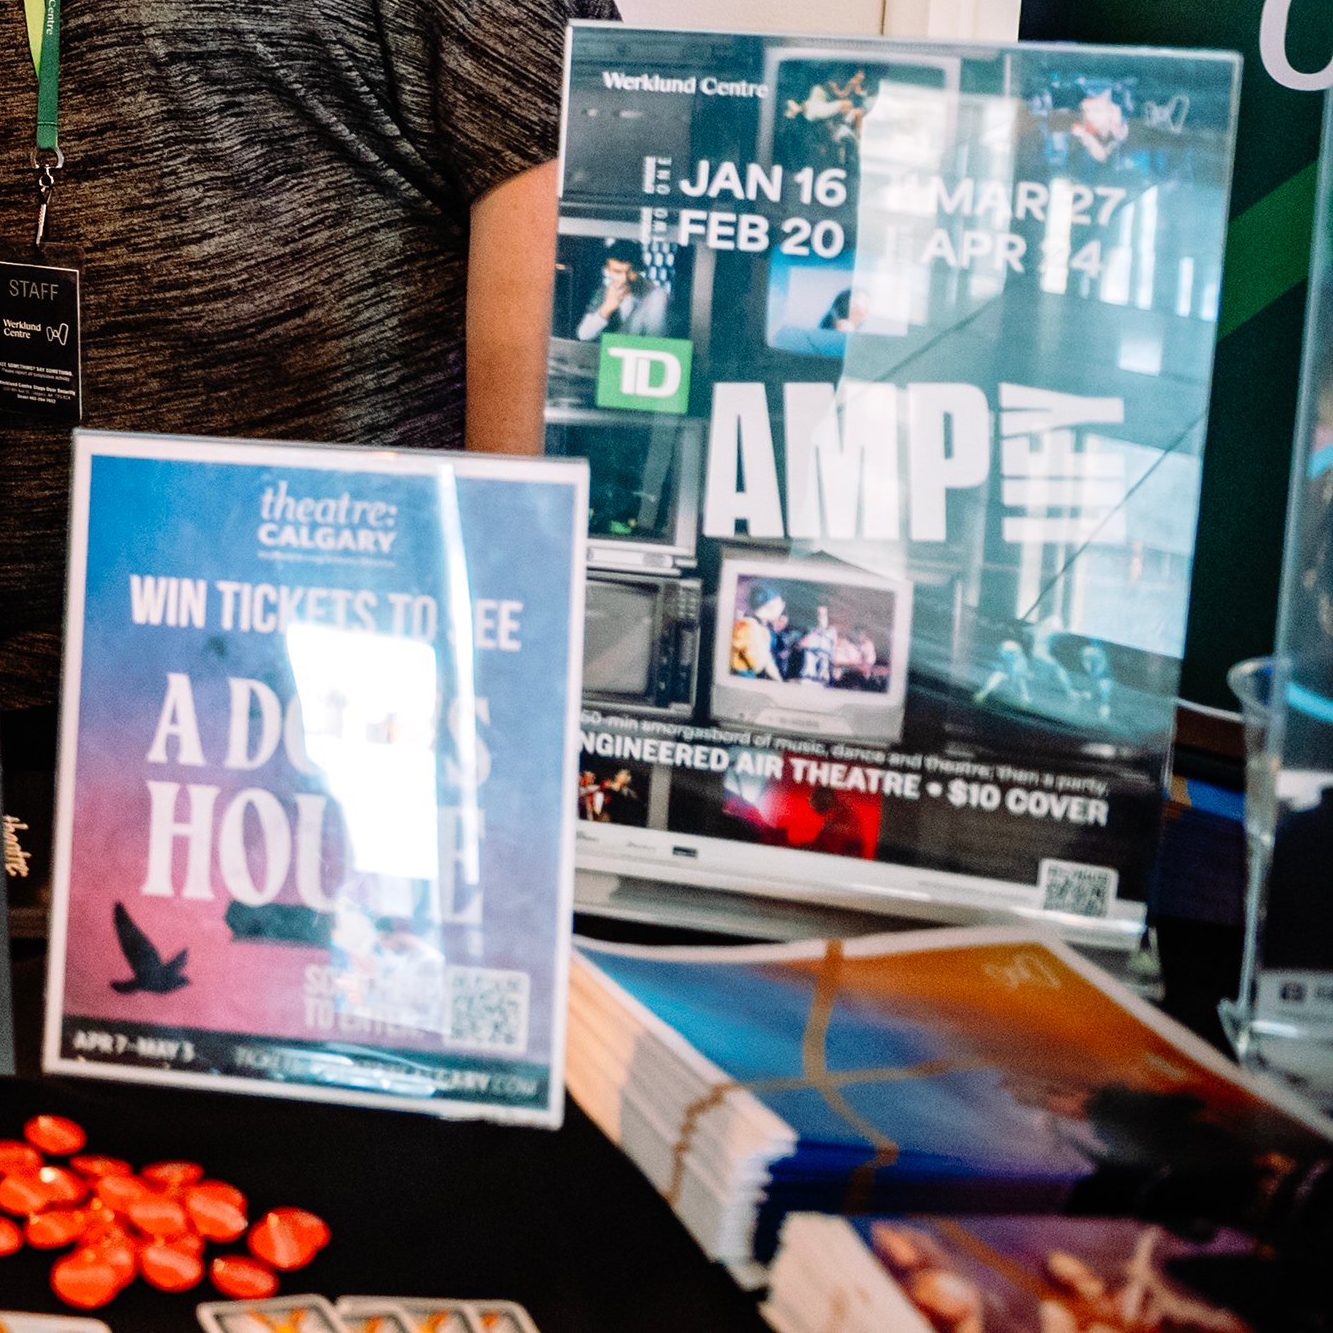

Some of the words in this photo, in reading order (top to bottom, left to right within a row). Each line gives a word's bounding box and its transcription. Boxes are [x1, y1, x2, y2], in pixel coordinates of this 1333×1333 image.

[603, 71, 696, 96] Werklund
[699, 78, 769, 98] Centre
[679, 160, 782, 203] JAN
[795, 167, 847, 207] 16
[934, 177, 1049, 222] MAR
[678, 210, 770, 253] FEB
[781, 217, 845, 259] 20
[920, 229, 1027, 273] APR
[9, 279, 59, 302] STAFF
[3, 318, 42, 332] Werklund
[4, 327, 31, 340] Centre
[607, 346, 683, 400] TD
[703, 382, 992, 542] AMP
[258, 479, 397, 527] theatre:
[258, 522, 398, 553] CALGARY
[130, 574, 207, 628] WIN
[390, 593, 436, 642] TO
[448, 599, 524, 651] EE
[147, 671, 205, 766] A
[579, 730, 730, 772] NGINEERED
[735, 752, 783, 780] AIR
[789, 757, 922, 800] THEATRE
[947, 777, 1002, 811] $10
[1005, 787, 1109, 827] COVER
[72, 1029, 114, 1055] APR
